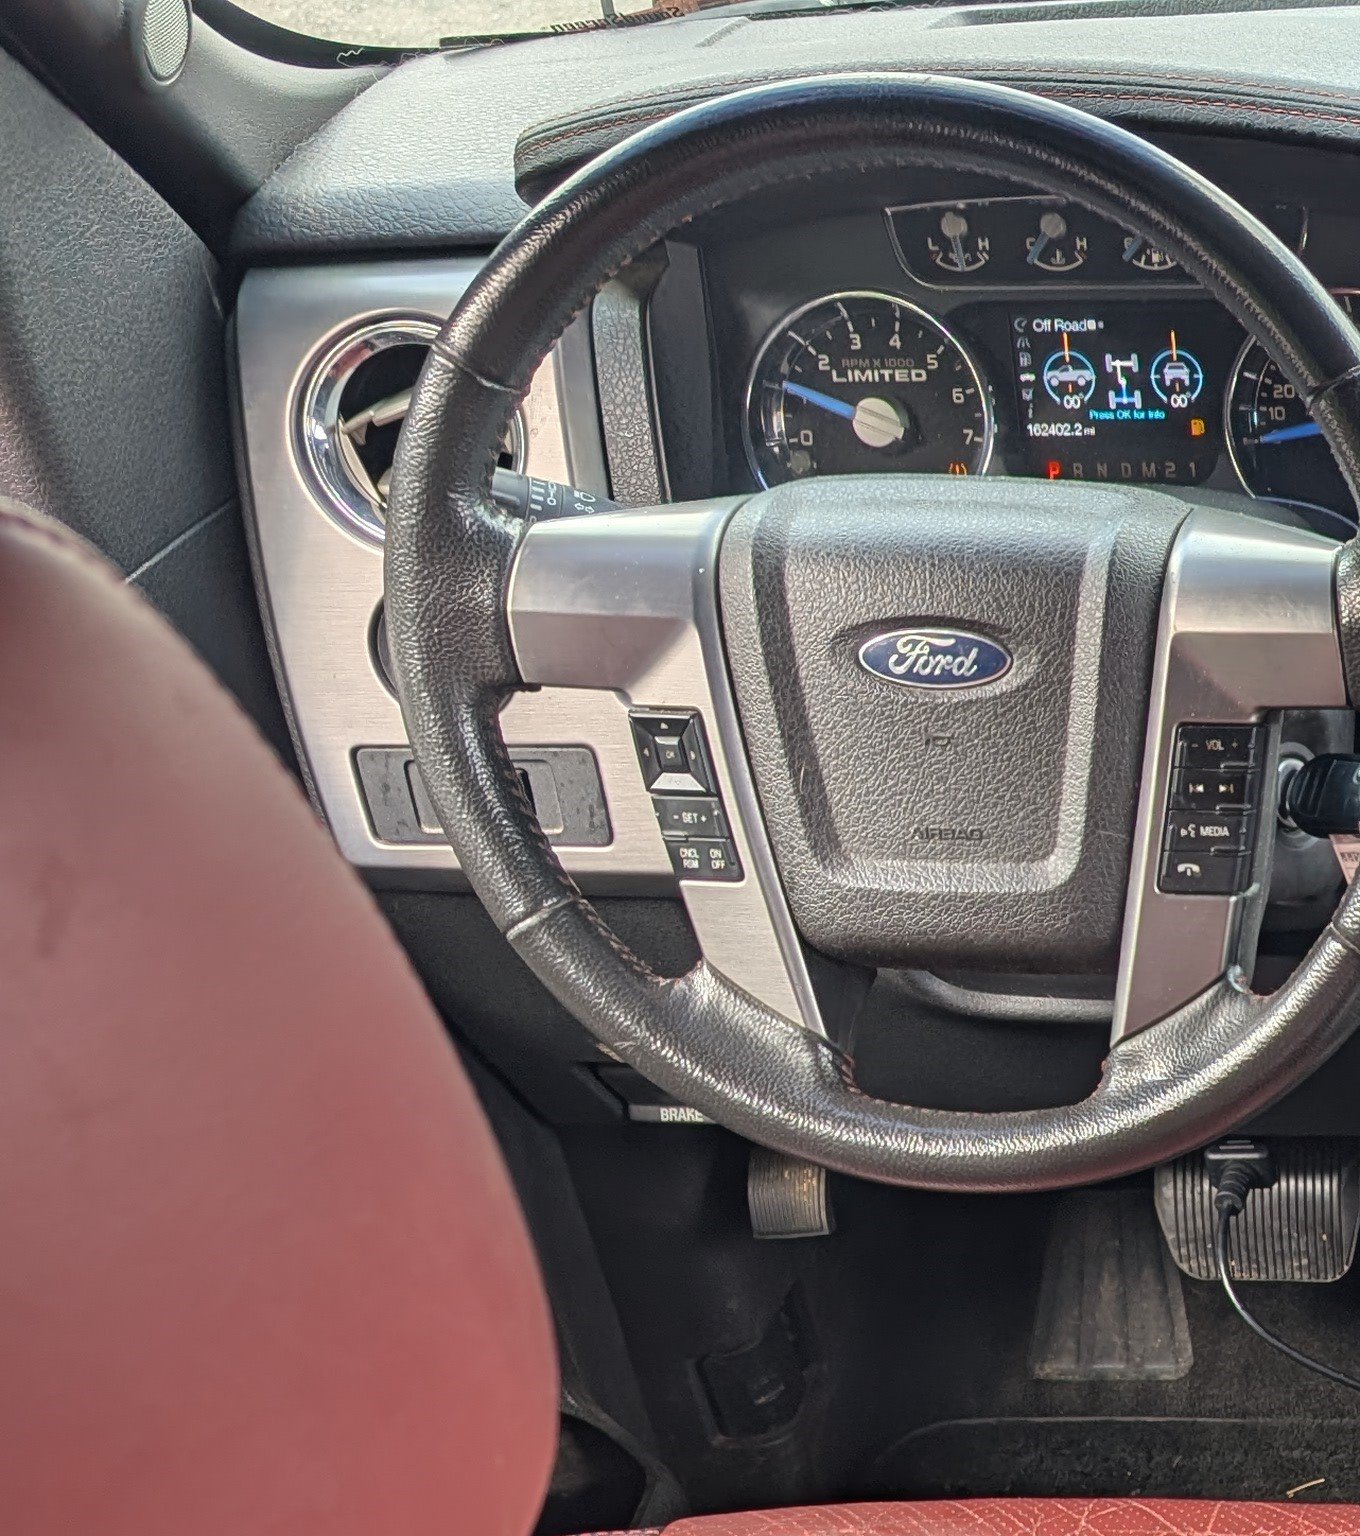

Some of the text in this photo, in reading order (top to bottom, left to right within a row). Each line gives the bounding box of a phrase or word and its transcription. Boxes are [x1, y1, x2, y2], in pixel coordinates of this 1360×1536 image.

[928, 237, 939, 250] L
[978, 237, 989, 250] H
[1077, 237, 1087, 250] H
[1033, 318, 1087, 332] Off Road
[850, 334, 862, 350] 3
[889, 334, 901, 349] 4
[818, 354, 830, 371] 2
[841, 359, 870, 368] RPM
[885, 358, 915, 368] 1000
[927, 354, 939, 370] 5
[832, 369, 927, 382] LIMITED
[952, 388, 964, 404] 6
[1273, 384, 1296, 399] 20
[1089, 410, 1115, 420] Press
[1117, 410, 1131, 419] OK
[1134, 410, 1145, 420] for
[1269, 407, 1286, 421] 10
[963, 429, 974, 445] 7
[1027, 423, 1083, 437] 162402.2
[801, 430, 813, 446] 0
[1049, 461, 1197, 480] P R N D M 2 1
[888, 634, 978, 677] Ford
[1206, 739, 1224, 751] VOL
[682, 813, 698, 823] SET
[1200, 825, 1229, 837] MEDIA
[710, 848, 722, 858] ON
[711, 860, 725, 869] OFF
[660, 1107, 703, 1122] BRAKE
